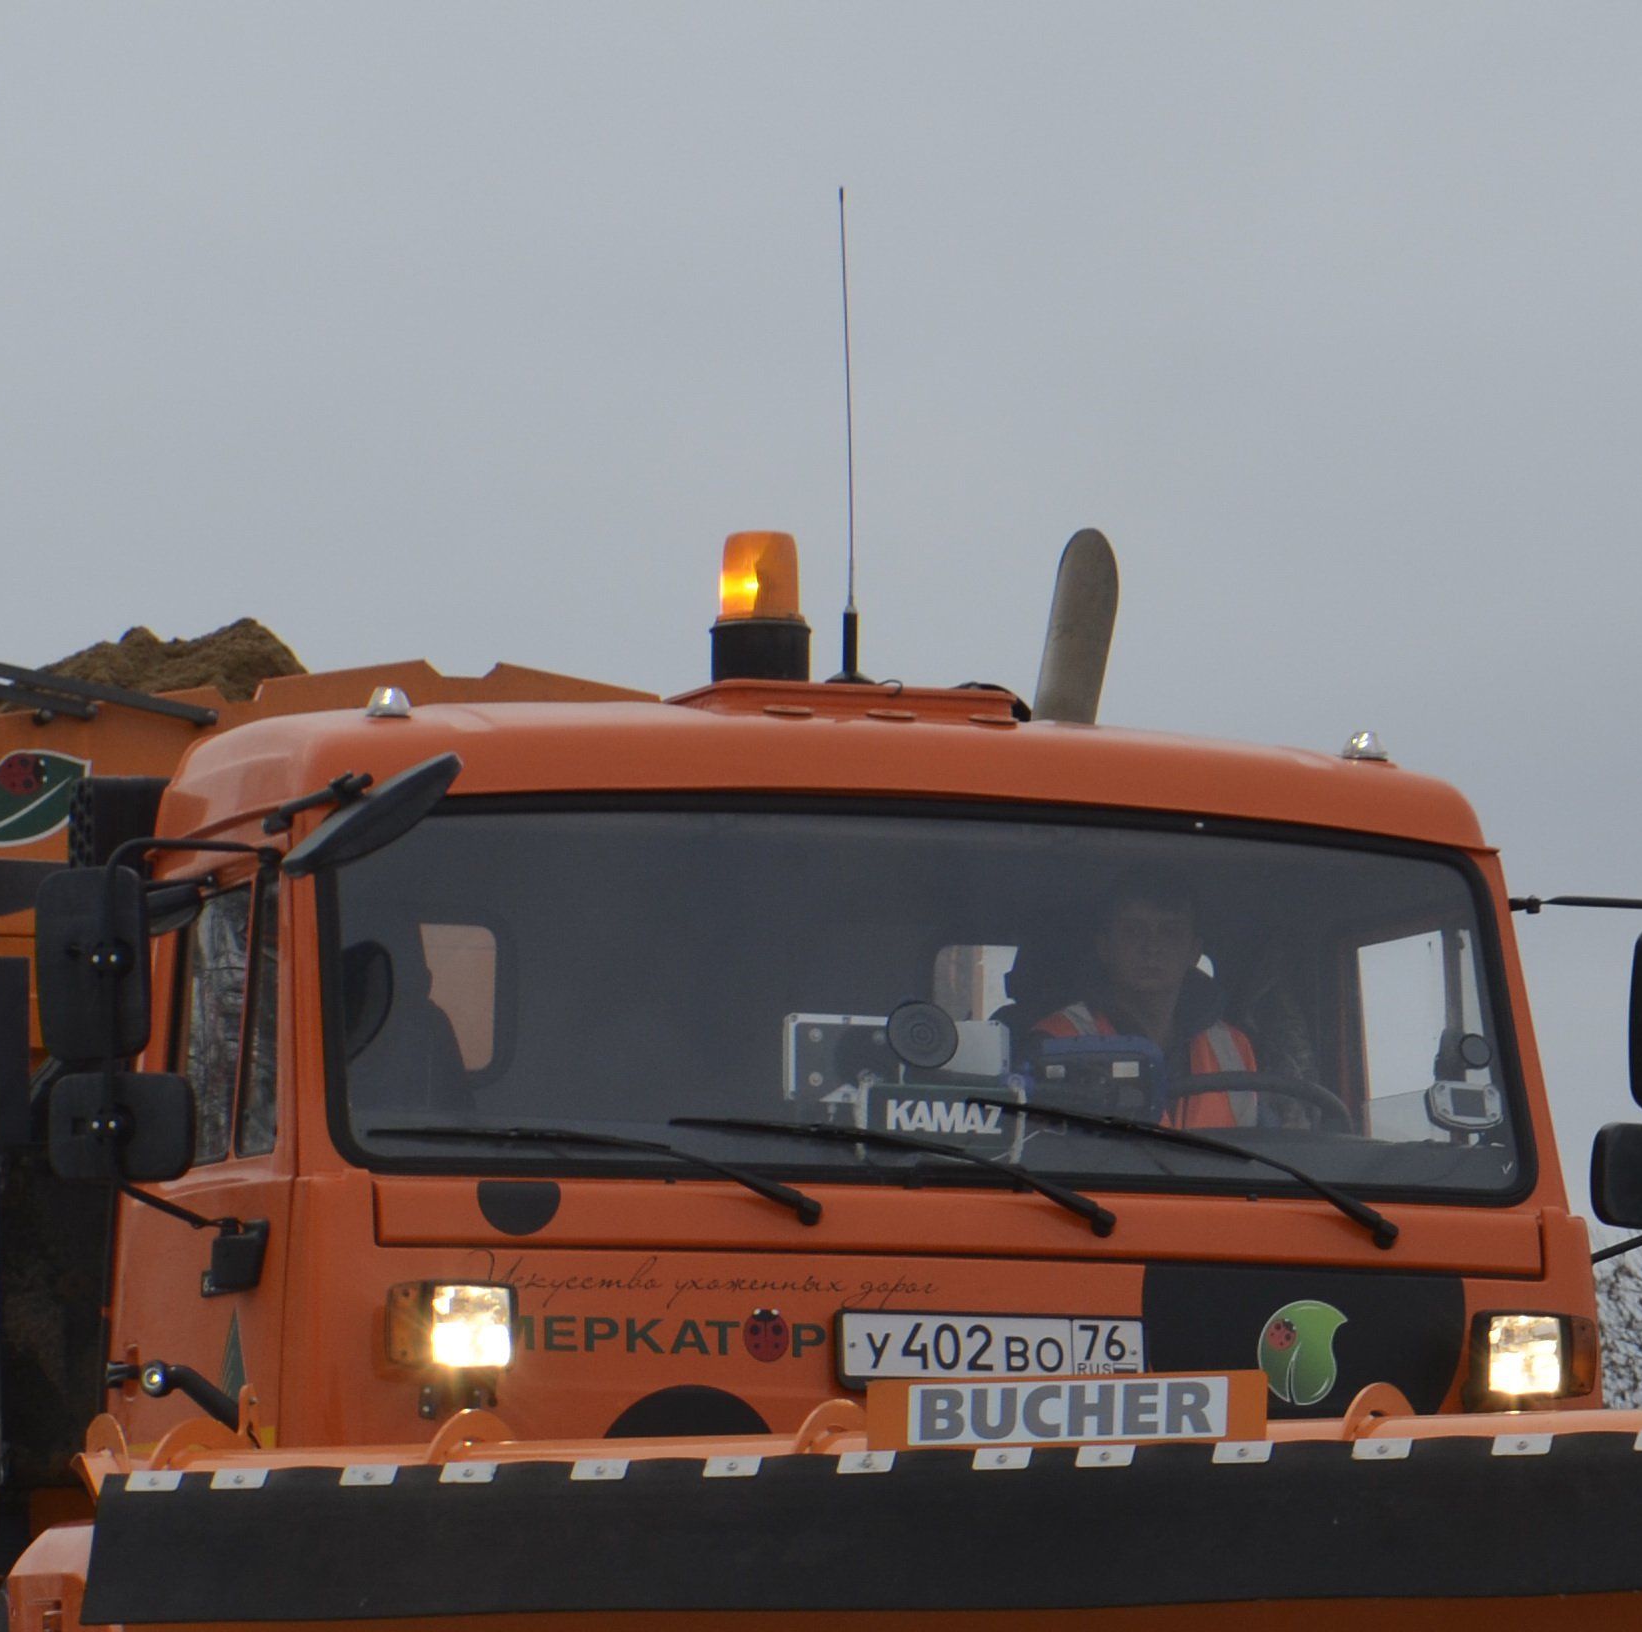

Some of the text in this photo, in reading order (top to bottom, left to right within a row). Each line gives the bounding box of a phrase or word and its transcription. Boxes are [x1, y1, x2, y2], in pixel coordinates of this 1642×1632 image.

[887, 1099, 1002, 1134] KAMAZ
[666, 1275, 845, 1310] ухоженных
[1078, 1324, 1126, 1361] 76
[1077, 1362, 1113, 1375] RUS
[919, 1381, 1212, 1441] BUCHER
